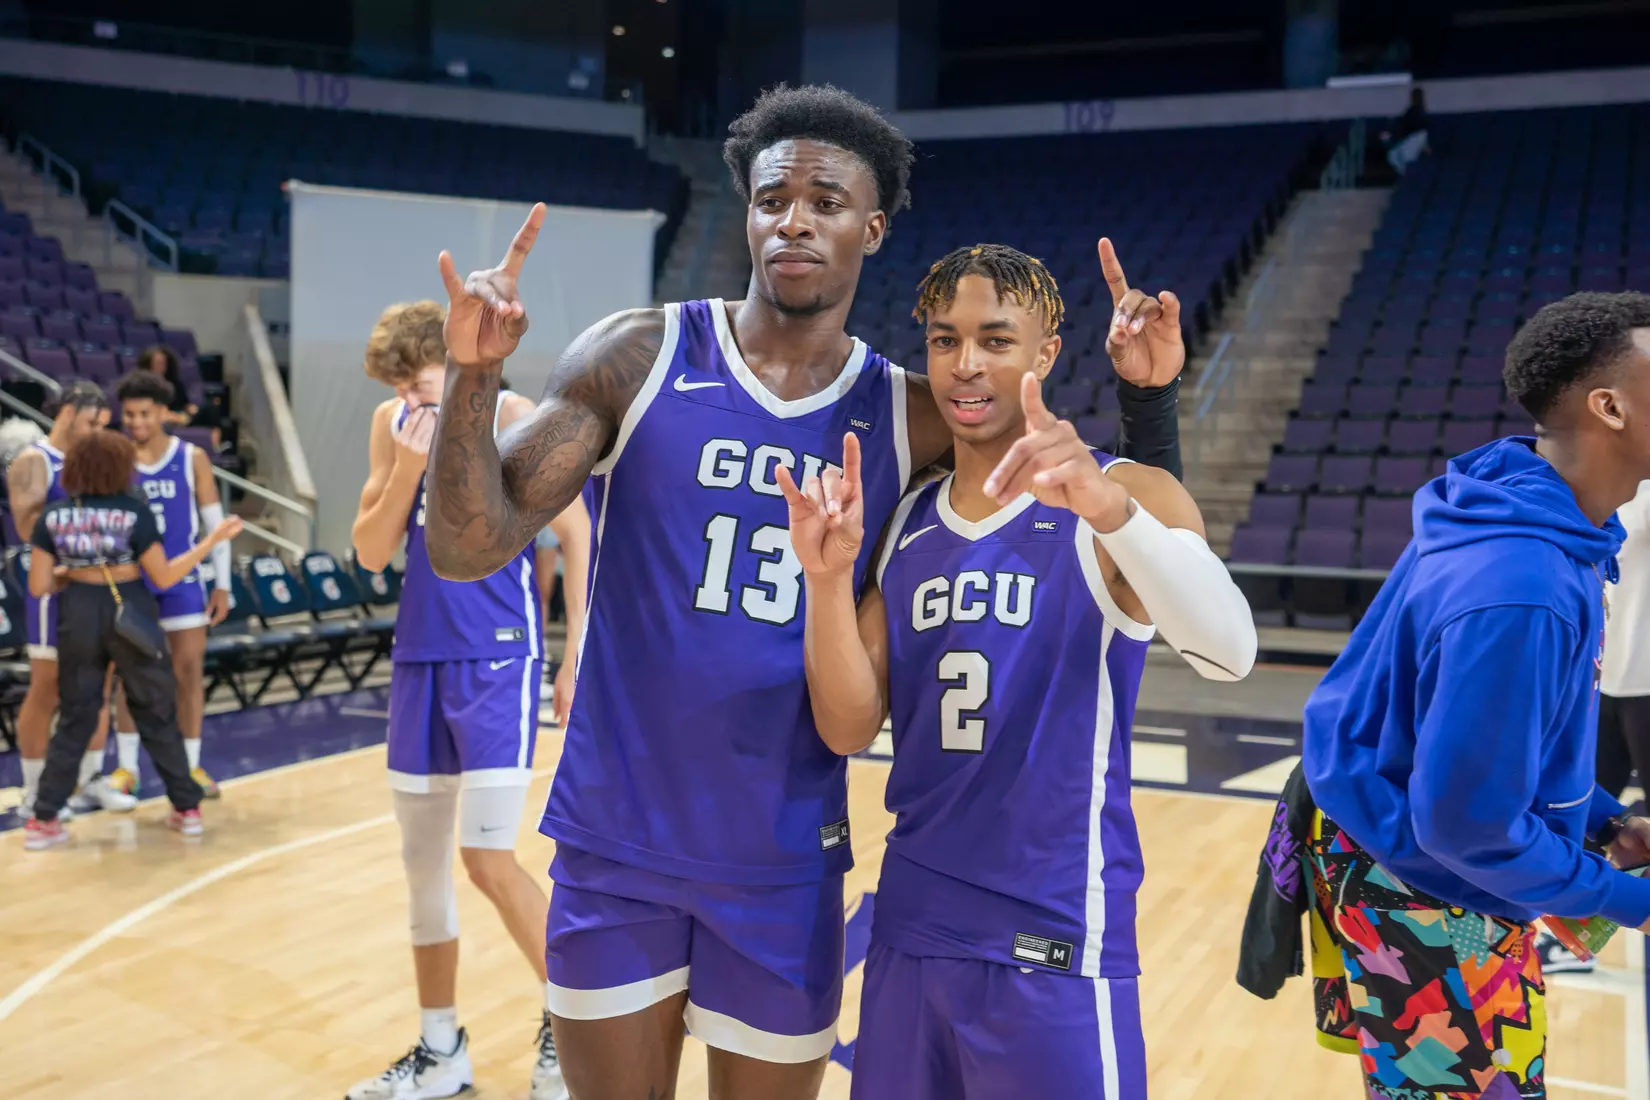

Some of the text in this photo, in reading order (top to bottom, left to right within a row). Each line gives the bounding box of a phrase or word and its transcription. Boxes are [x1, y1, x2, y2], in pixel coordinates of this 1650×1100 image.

[295, 70, 350, 109] 110
[1064, 100, 1115, 132] 109
[850, 418, 871, 431] WAC
[142, 479, 177, 500] CU
[1034, 521, 1057, 530] WAC
[692, 511, 804, 627] 13
[911, 570, 1037, 634] GCU
[936, 650, 991, 754] 2
[840, 826, 848, 837] XL
[1052, 948, 1066, 961] M
